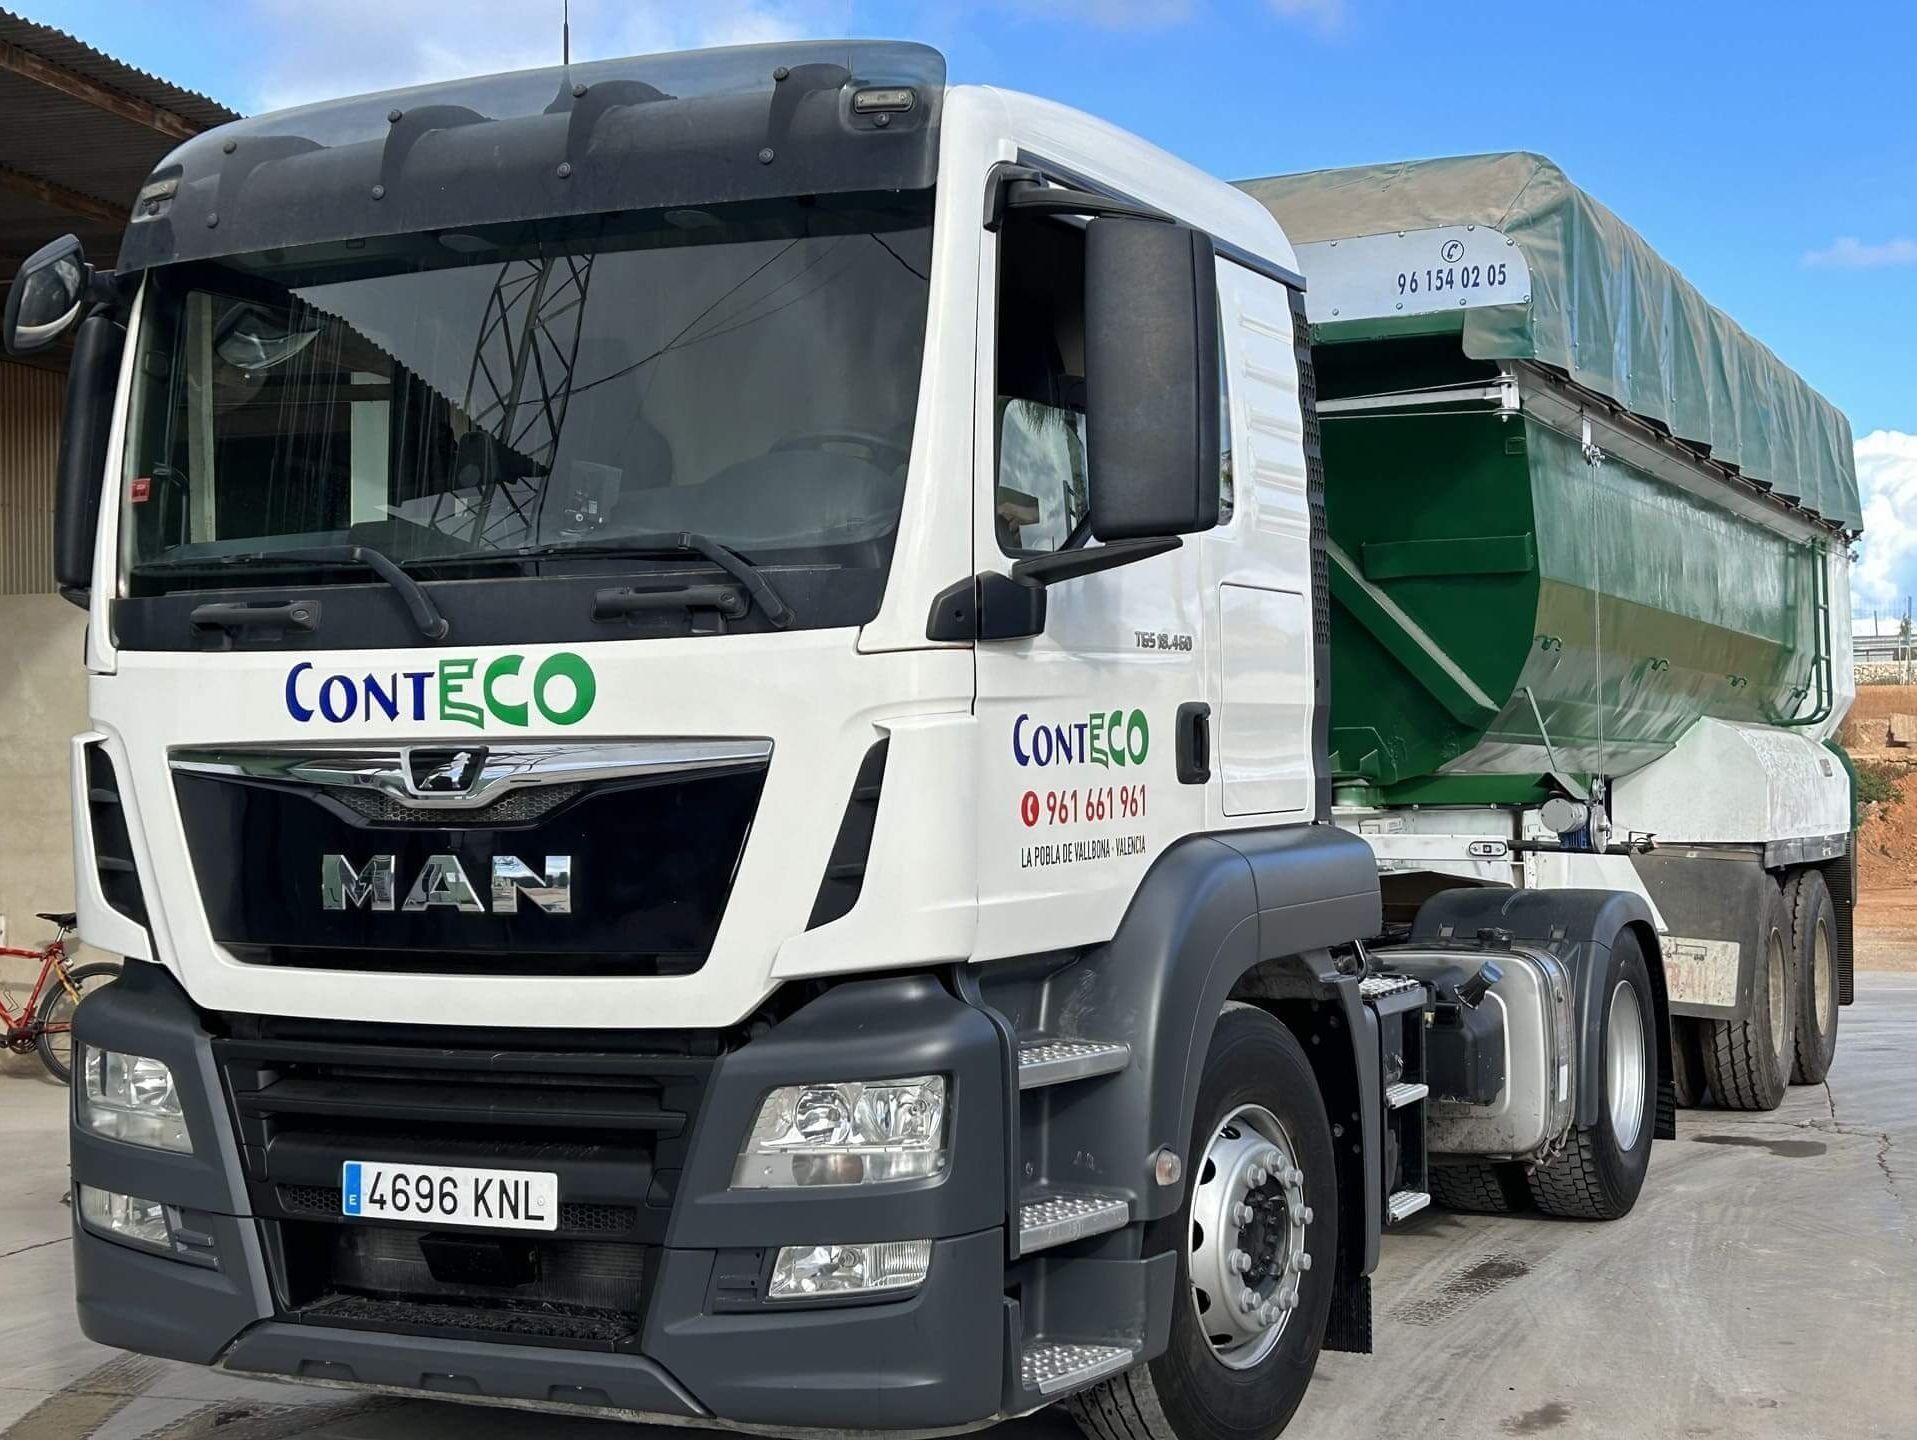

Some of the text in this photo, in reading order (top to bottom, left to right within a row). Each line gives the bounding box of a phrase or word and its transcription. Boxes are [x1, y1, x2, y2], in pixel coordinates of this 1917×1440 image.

[1398, 263, 1506, 295] 96 154 02 05
[1046, 784, 1146, 825] 961 661 961
[1021, 847, 1032, 868] LA
[1034, 844, 1061, 867] POBLA
[1062, 842, 1073, 863] DE
[1074, 838, 1110, 862] VALLBONA
[1115, 835, 1146, 857] VALENCIA
[322, 854, 572, 913] MAN
[349, 1171, 545, 1221] E 4696 KNL
